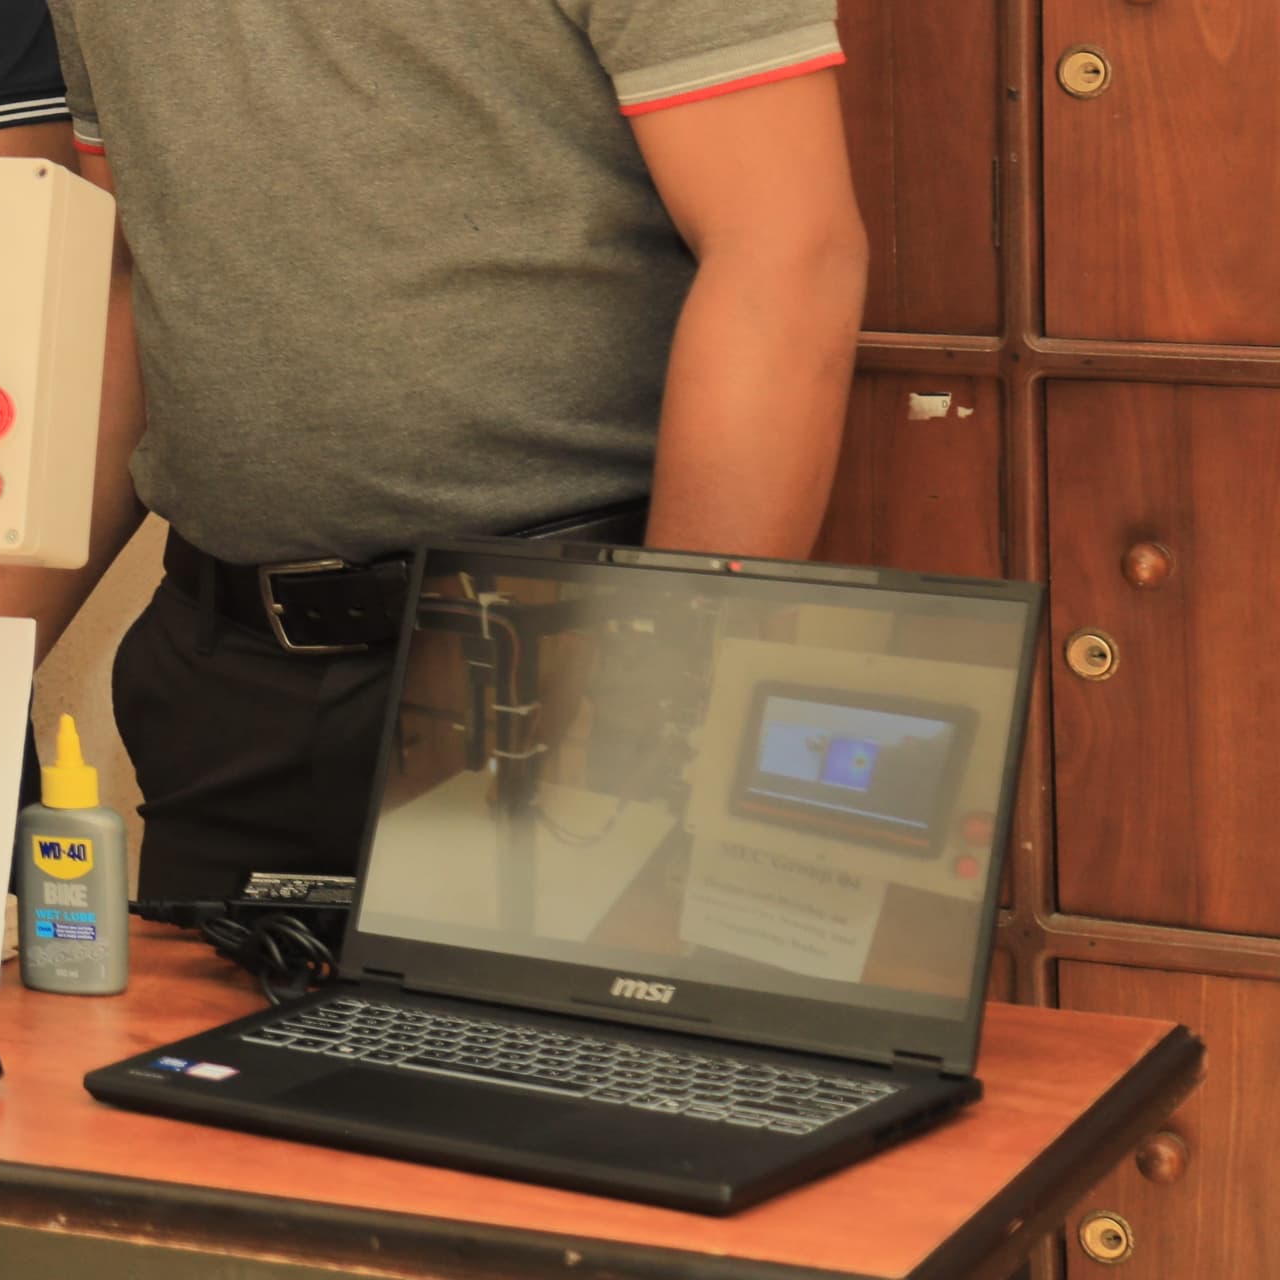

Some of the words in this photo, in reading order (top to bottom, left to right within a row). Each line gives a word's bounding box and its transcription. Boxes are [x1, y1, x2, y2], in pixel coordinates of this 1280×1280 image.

[39, 840, 87, 862] WD-40
[42, 880, 89, 908] BIKE
[35, 908, 62, 921] WET
[610, 976, 676, 1004] msi
